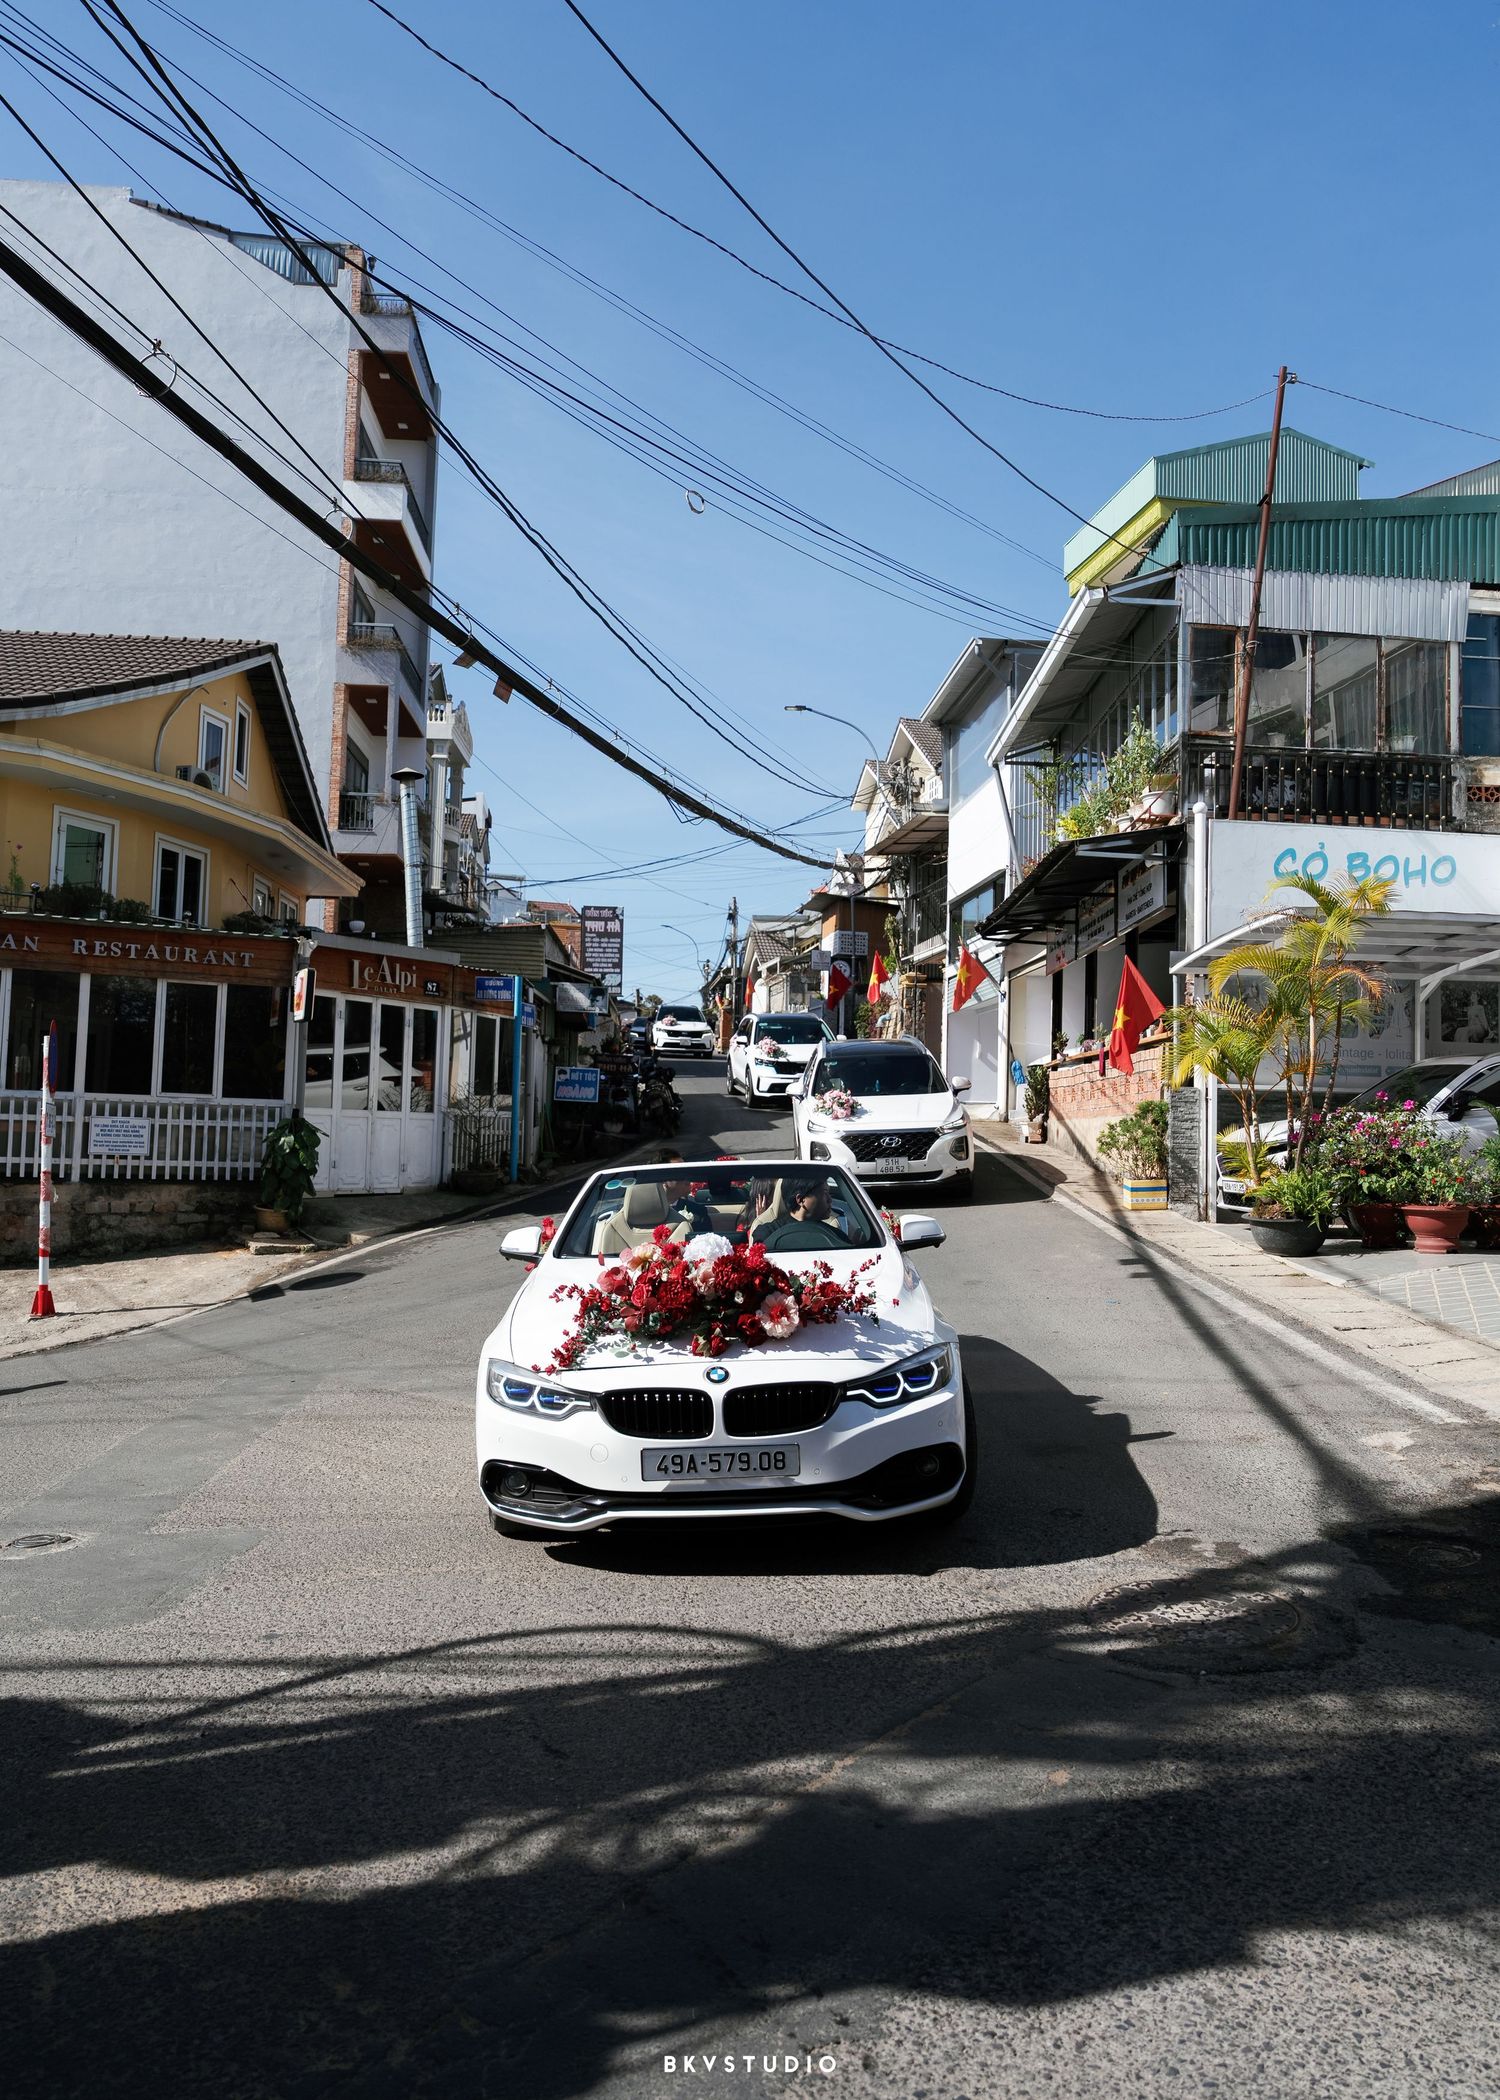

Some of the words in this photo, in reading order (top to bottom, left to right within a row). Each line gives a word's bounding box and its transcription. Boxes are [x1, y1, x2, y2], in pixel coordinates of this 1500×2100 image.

[1273, 841, 1329, 881] CỎ
[1346, 851, 1457, 888] BOHO
[584, 920, 606, 932] THU
[72, 938, 255, 967] RESTAURANT
[426, 981, 438, 992] 87
[1334, 1048, 1374, 1061] intage
[1385, 1047, 1412, 1060] lolita
[585, 1071, 596, 1081] TÓC
[885, 1158, 899, 1166] 51H
[880, 1165, 905, 1173] 488.52
[656, 1451, 786, 1475] 49A-579.08
